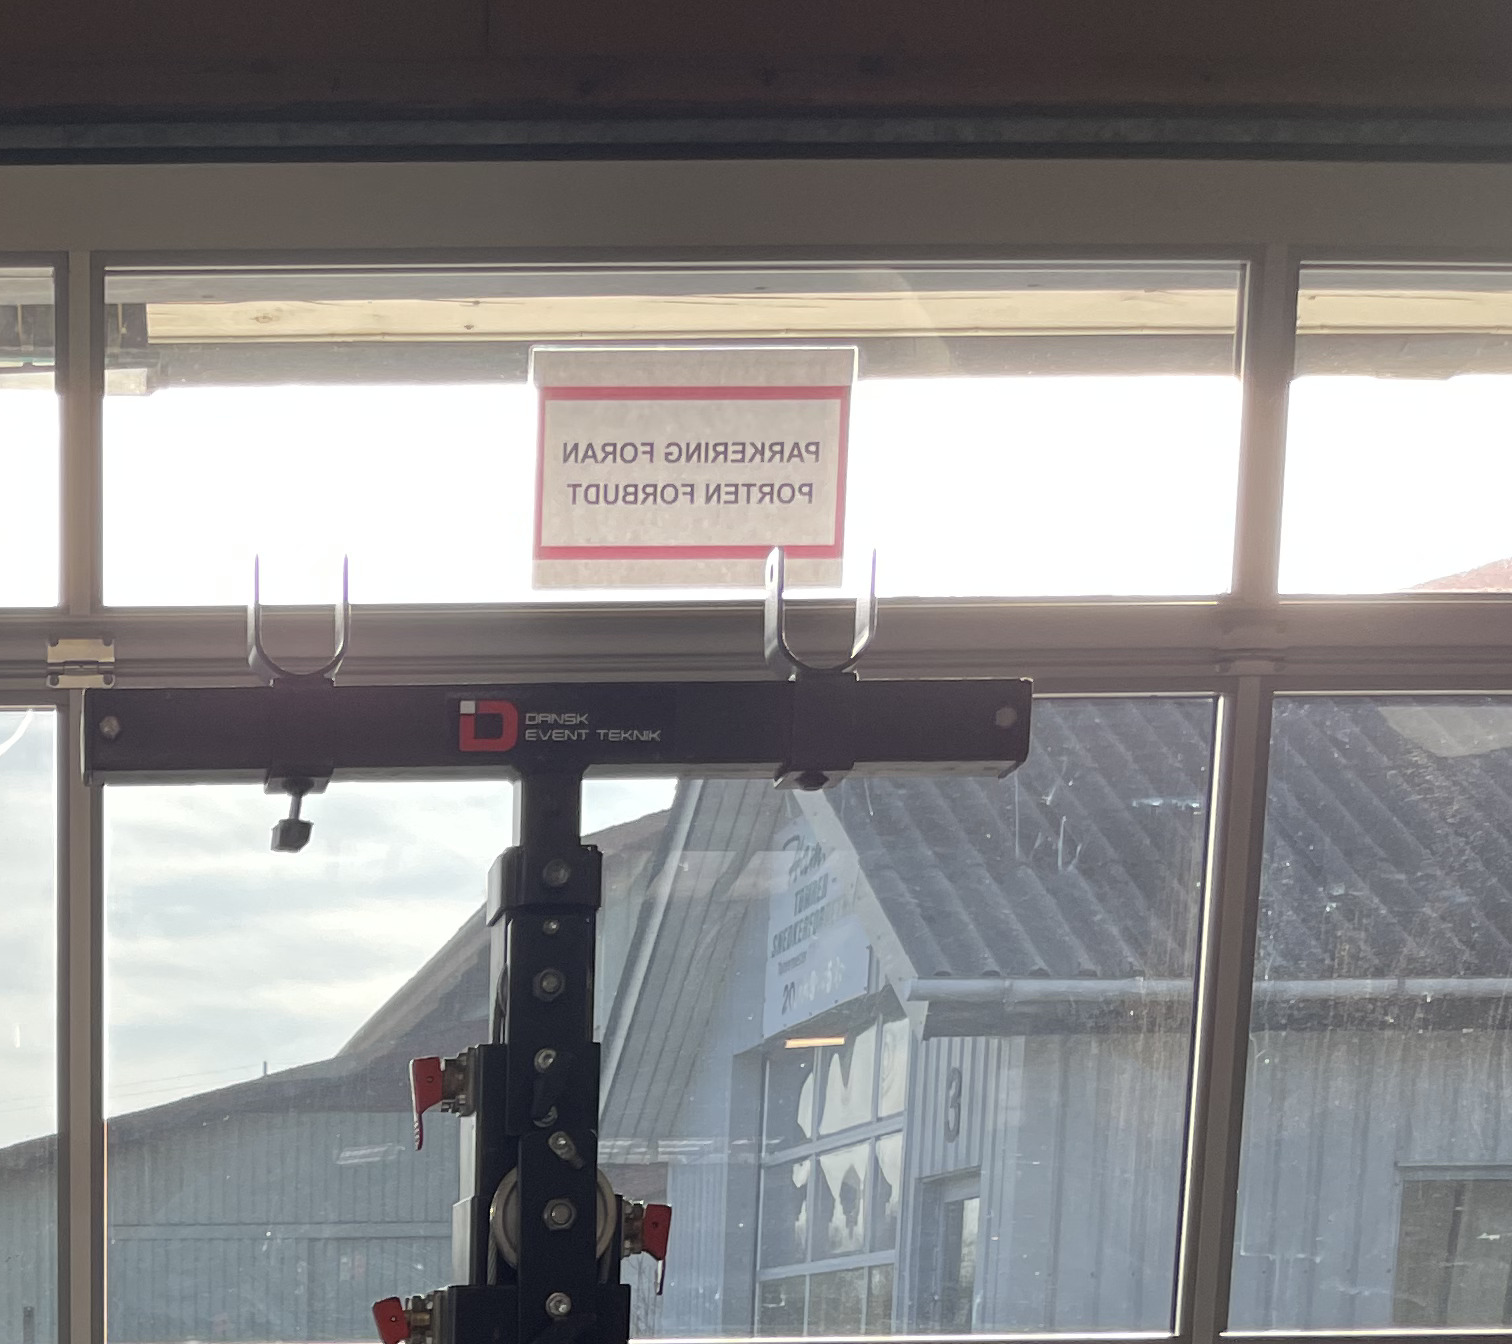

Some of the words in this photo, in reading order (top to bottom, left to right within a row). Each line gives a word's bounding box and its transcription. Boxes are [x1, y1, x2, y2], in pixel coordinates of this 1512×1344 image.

[524, 712, 589, 725] DANSK
[524, 729, 590, 741] EVENT
[596, 729, 662, 742] TEKNIK
[944, 1066, 963, 1144] 3
